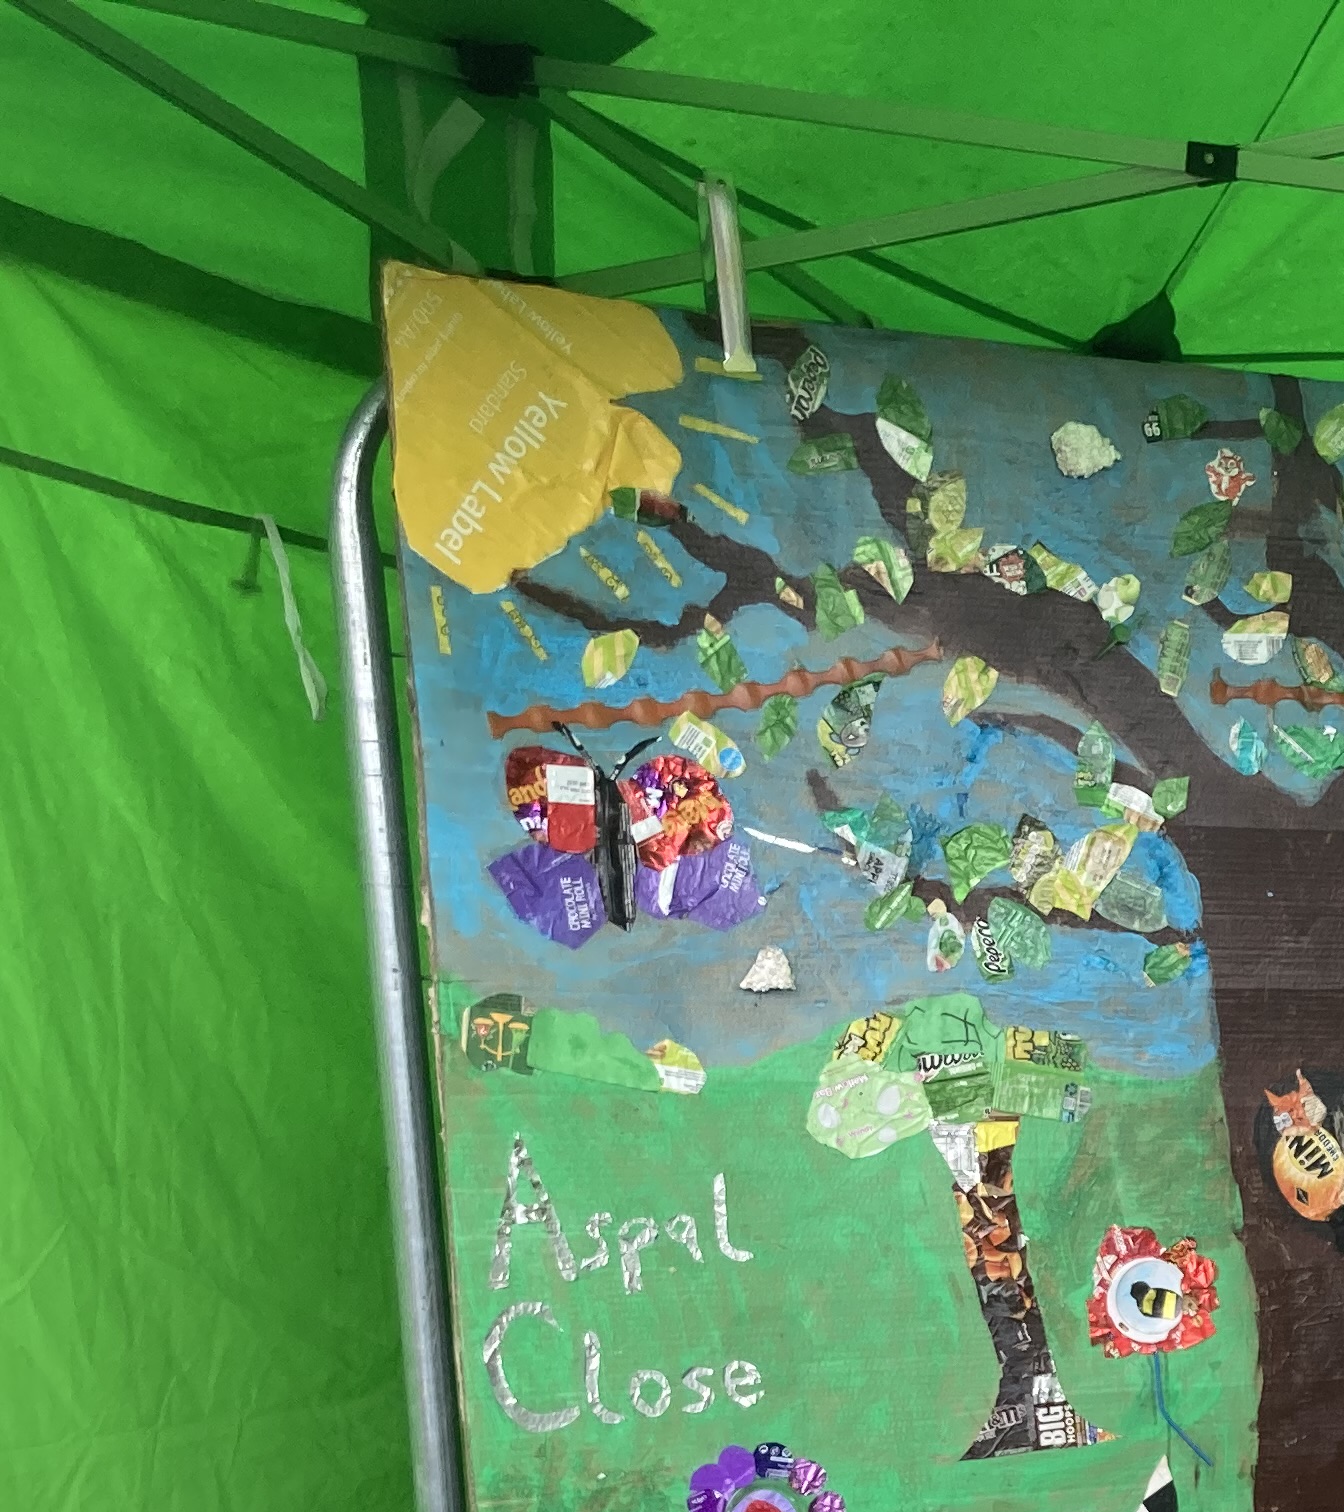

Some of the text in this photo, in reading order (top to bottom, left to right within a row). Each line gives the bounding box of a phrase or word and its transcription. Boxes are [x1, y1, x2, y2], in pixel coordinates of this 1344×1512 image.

[469, 360, 527, 434] Standard
[434, 391, 568, 566] Yellow Label
[560, 876, 581, 931] CHOCOLATE
[488, 1132, 754, 1295] Aspal
[482, 1300, 766, 1433] Close
[1036, 1404, 1067, 1447] BIG
[1065, 1403, 1077, 1443] HOOPS
